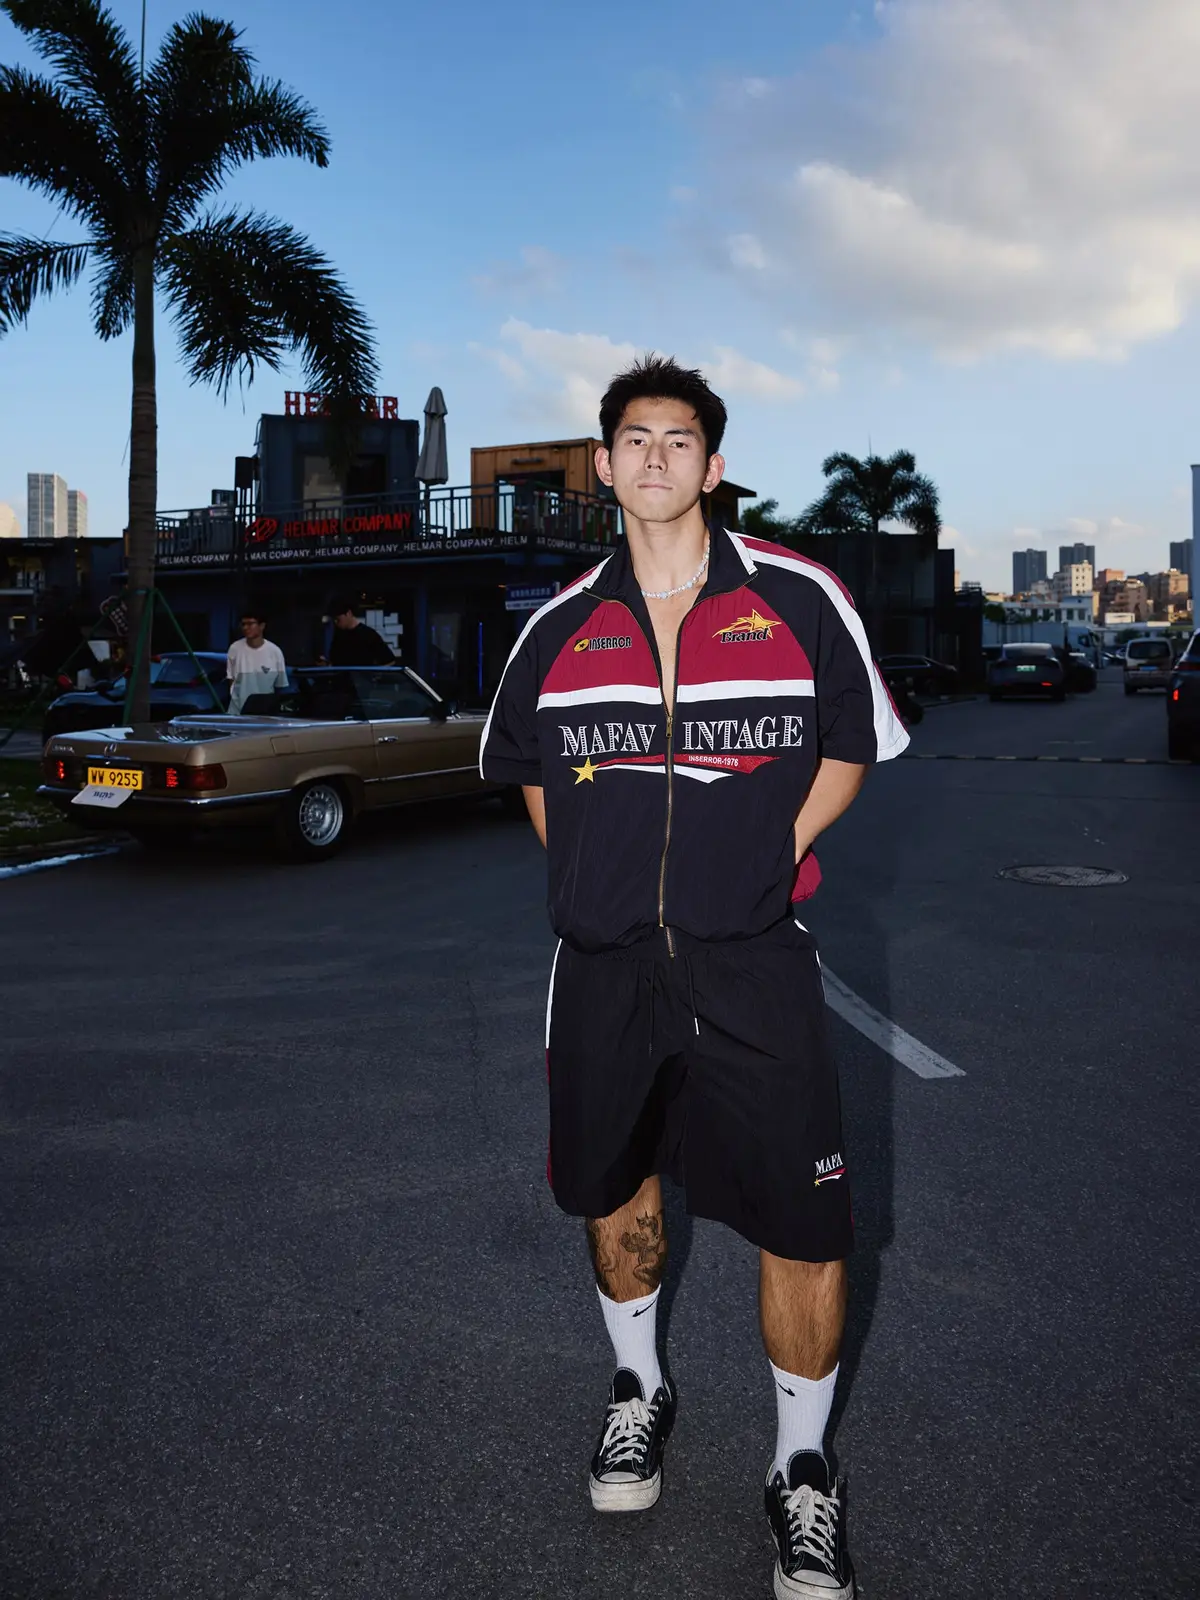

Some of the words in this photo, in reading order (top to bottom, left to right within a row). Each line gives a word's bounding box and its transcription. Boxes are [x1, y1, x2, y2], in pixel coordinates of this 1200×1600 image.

[284, 391, 398, 421] HEAR
[284, 519, 340, 538] HELMAR
[343, 511, 413, 534] COMPANY
[159, 555, 190, 565] HELMAR
[315, 546, 351, 557] HELMAR
[403, 541, 443, 552] HELMAR
[589, 636, 632, 651] INSERROR
[720, 627, 769, 643] Brand
[558, 722, 657, 756] MAFAV
[682, 716, 803, 751] INTAGE
[688, 755, 739, 767] INSERROR-1976
[109, 772, 139, 787] 9255
[815, 1152, 843, 1176] MAFA
